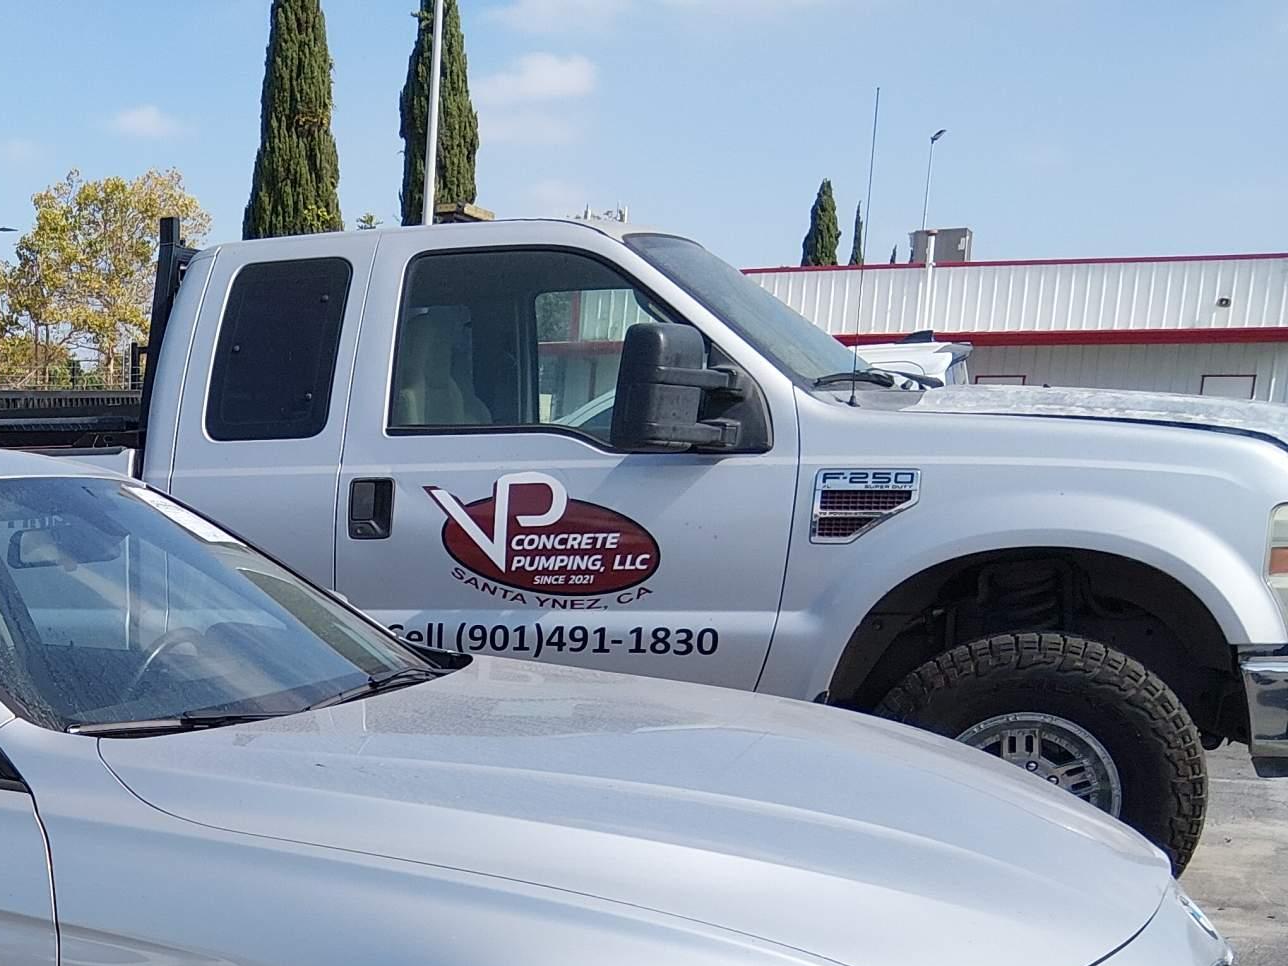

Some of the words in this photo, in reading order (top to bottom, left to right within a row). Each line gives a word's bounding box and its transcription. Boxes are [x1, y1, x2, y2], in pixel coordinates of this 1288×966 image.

[822, 472, 915, 484] F-250
[422, 472, 568, 574] VP
[512, 533, 621, 550] CONCRETE
[511, 555, 605, 573] PUMPING,
[613, 554, 650, 570] LLC
[451, 567, 528, 604] SANTA
[535, 596, 609, 611] YNEZ,
[616, 586, 653, 605] CA
[533, 575, 565, 585] SINCE
[568, 575, 594, 585] 2021
[455, 622, 719, 657] (901)491-1830
